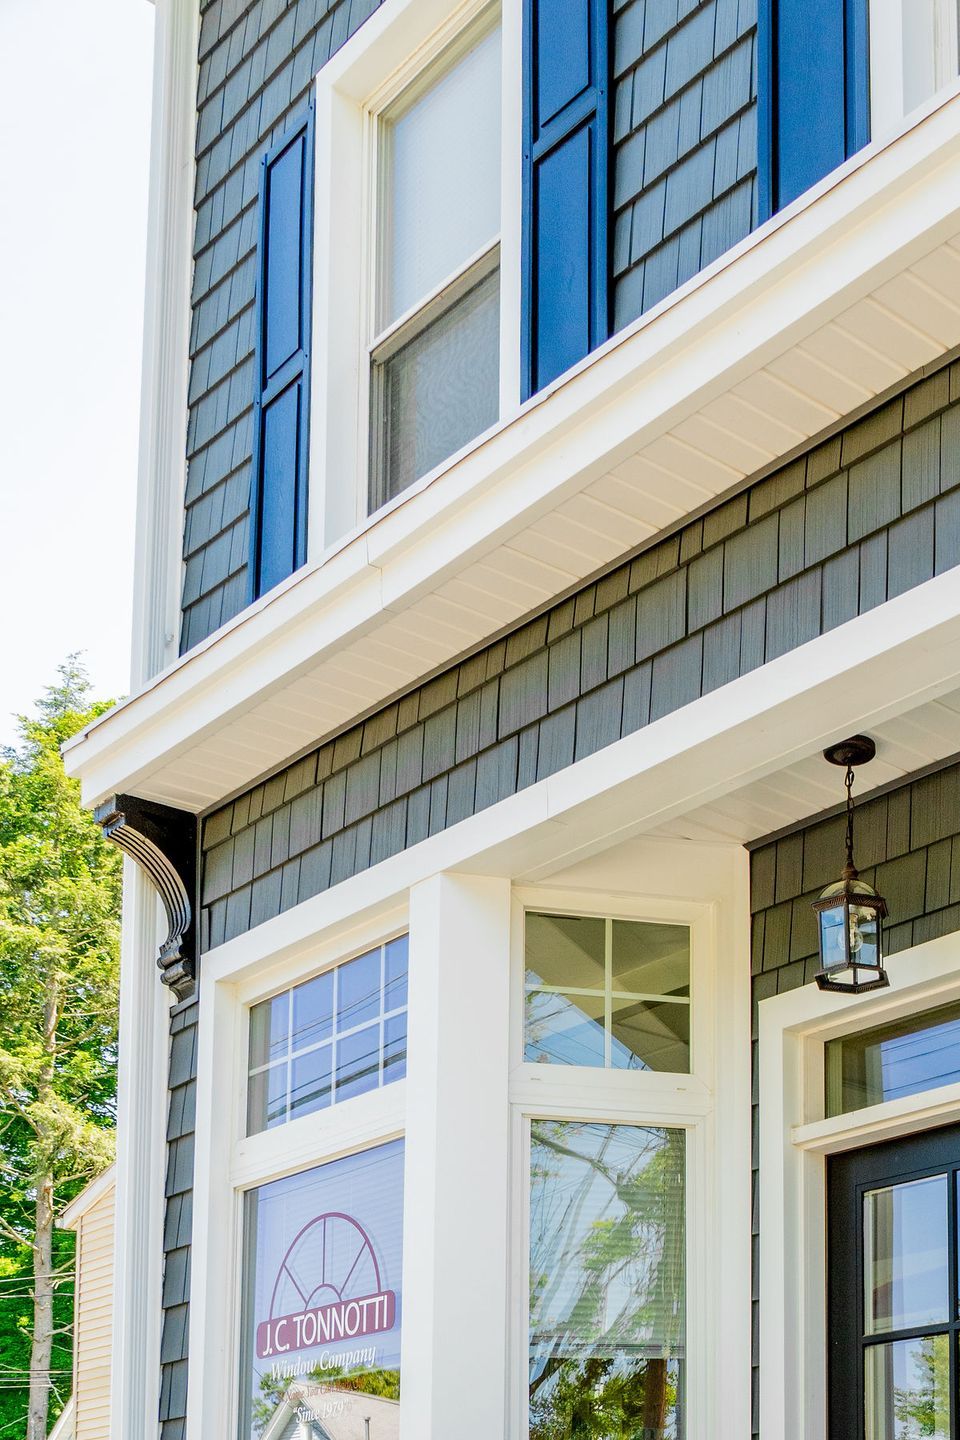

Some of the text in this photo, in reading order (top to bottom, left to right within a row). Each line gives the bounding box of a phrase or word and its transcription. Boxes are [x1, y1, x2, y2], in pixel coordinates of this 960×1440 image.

[293, 1295, 388, 1347] TONNOTTI
[272, 1346, 376, 1380] Window Company
